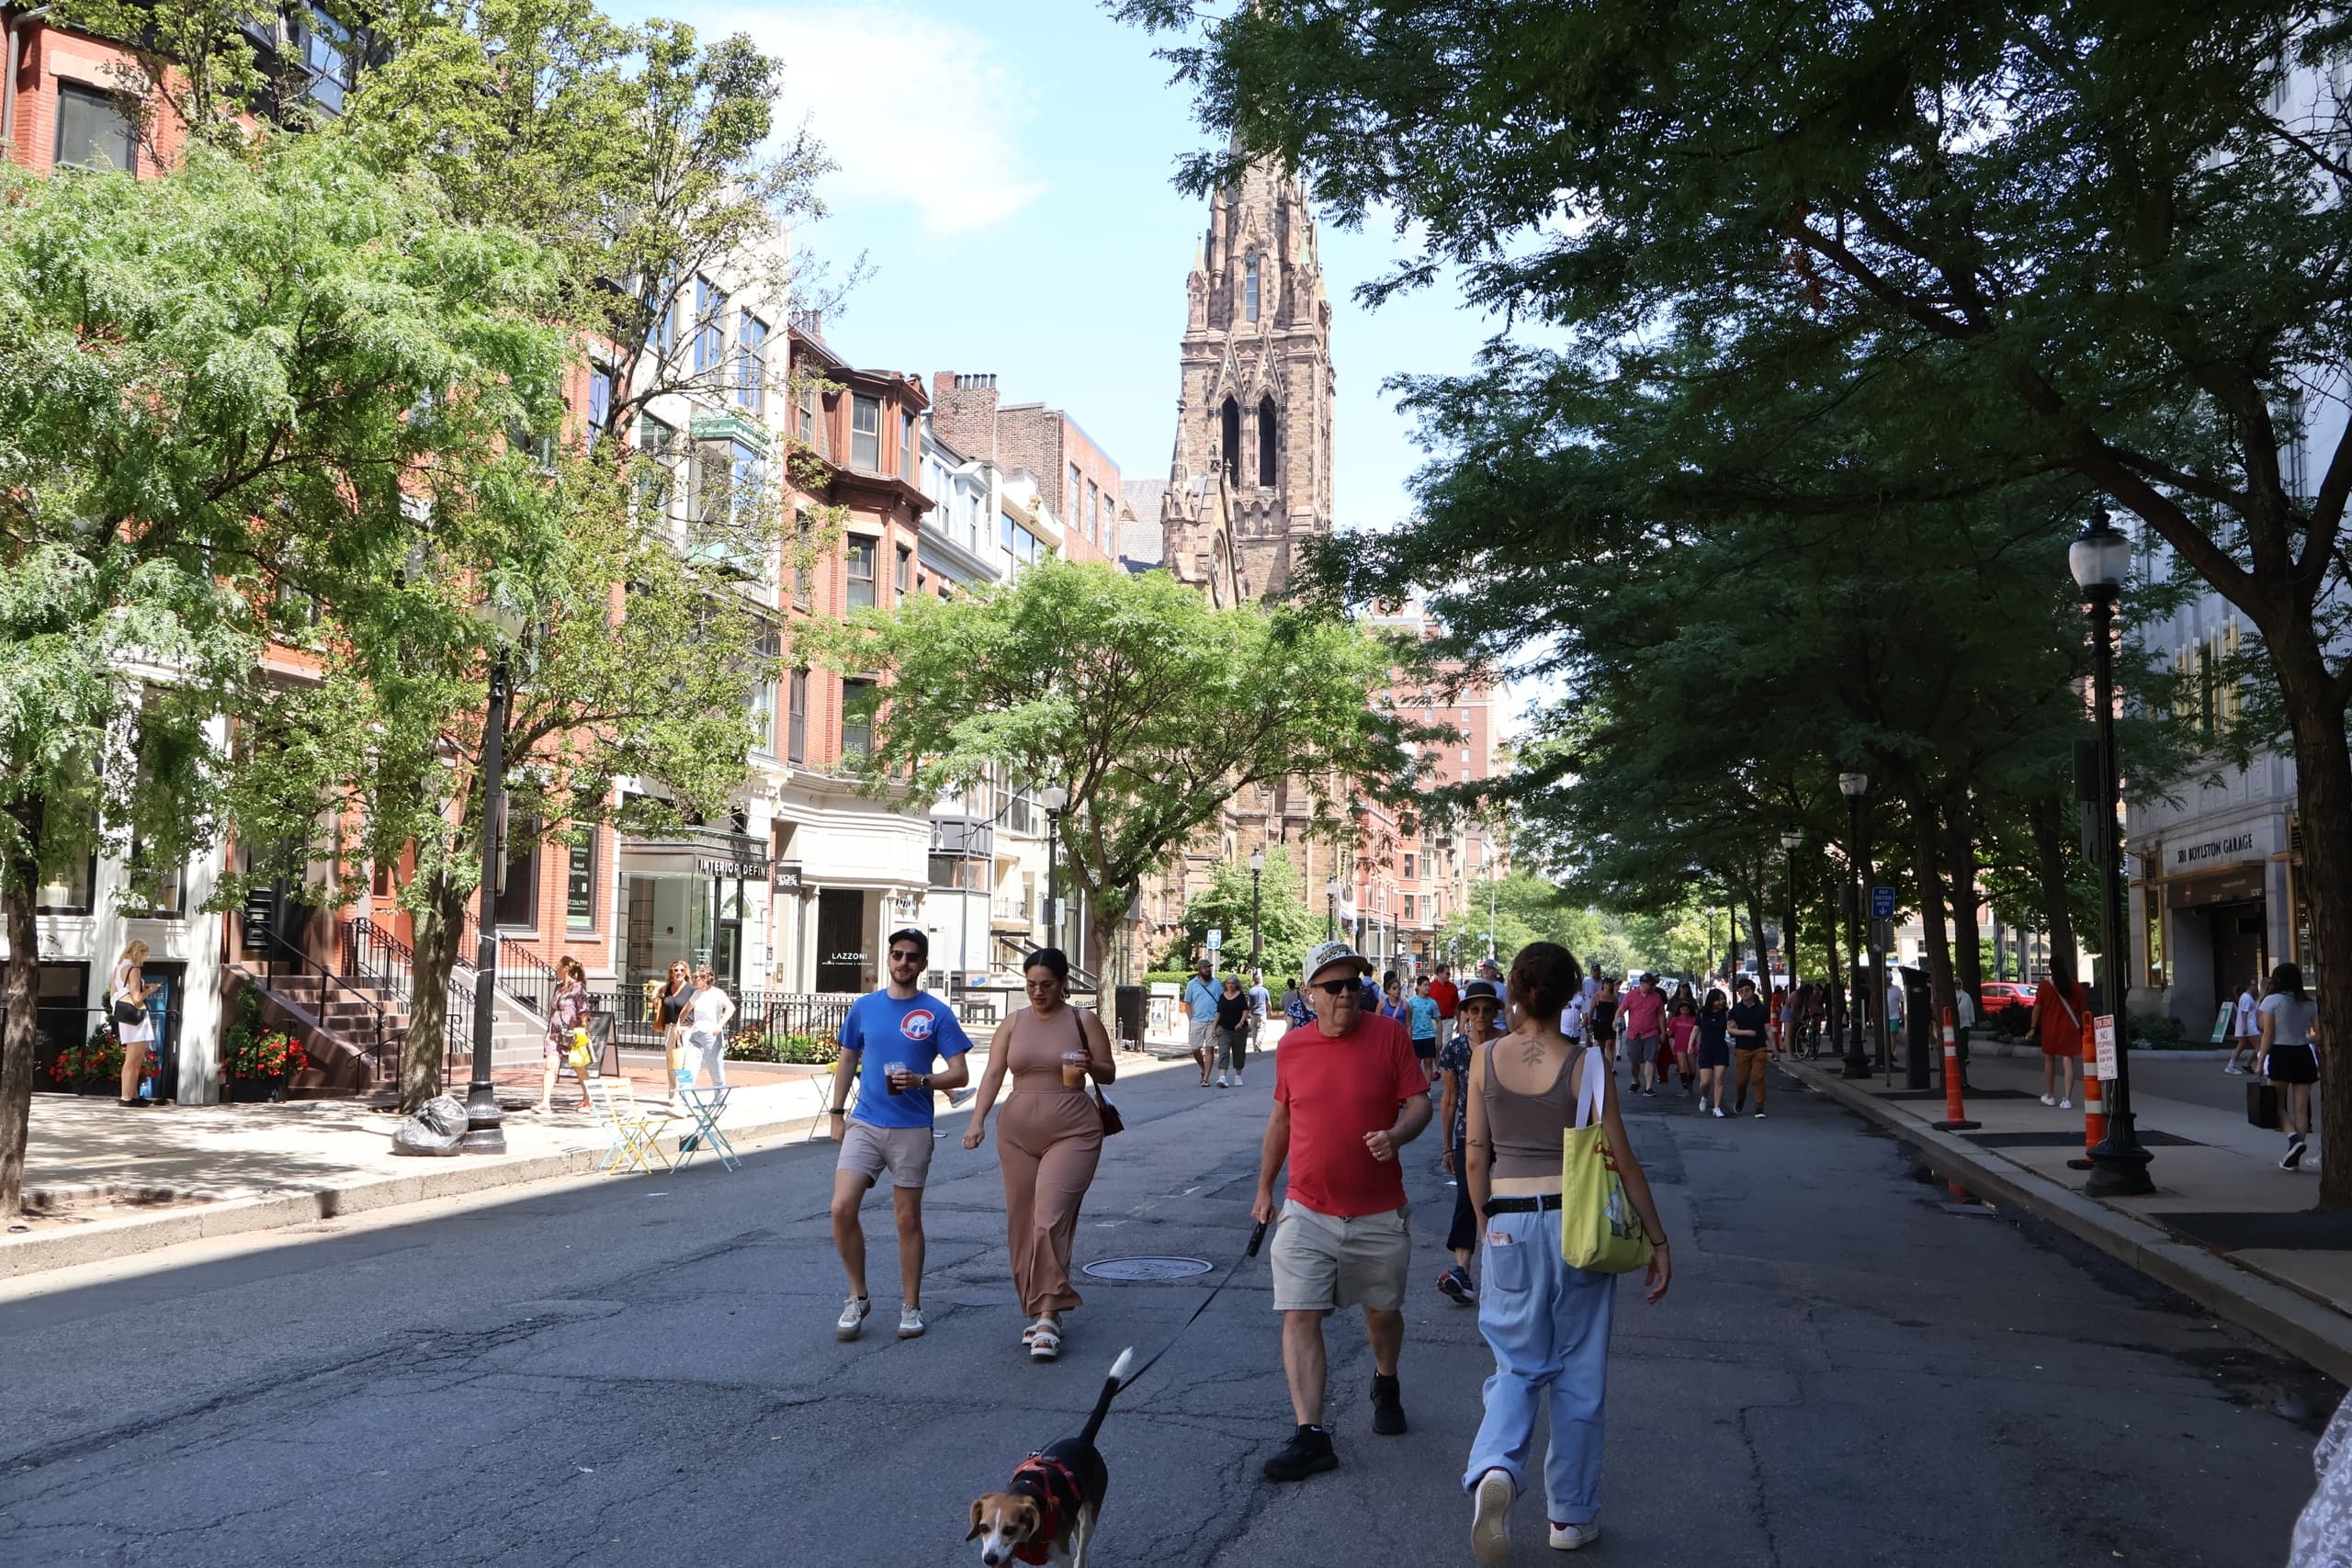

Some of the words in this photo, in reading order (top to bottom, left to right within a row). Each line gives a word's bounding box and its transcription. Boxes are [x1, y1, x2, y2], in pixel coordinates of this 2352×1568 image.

[2188, 841, 2222, 862] BOYLSTON
[2223, 833, 2253, 854] GARAGE
[699, 859, 740, 874] INTERIOR
[2100, 1031, 2109, 1040] NO
